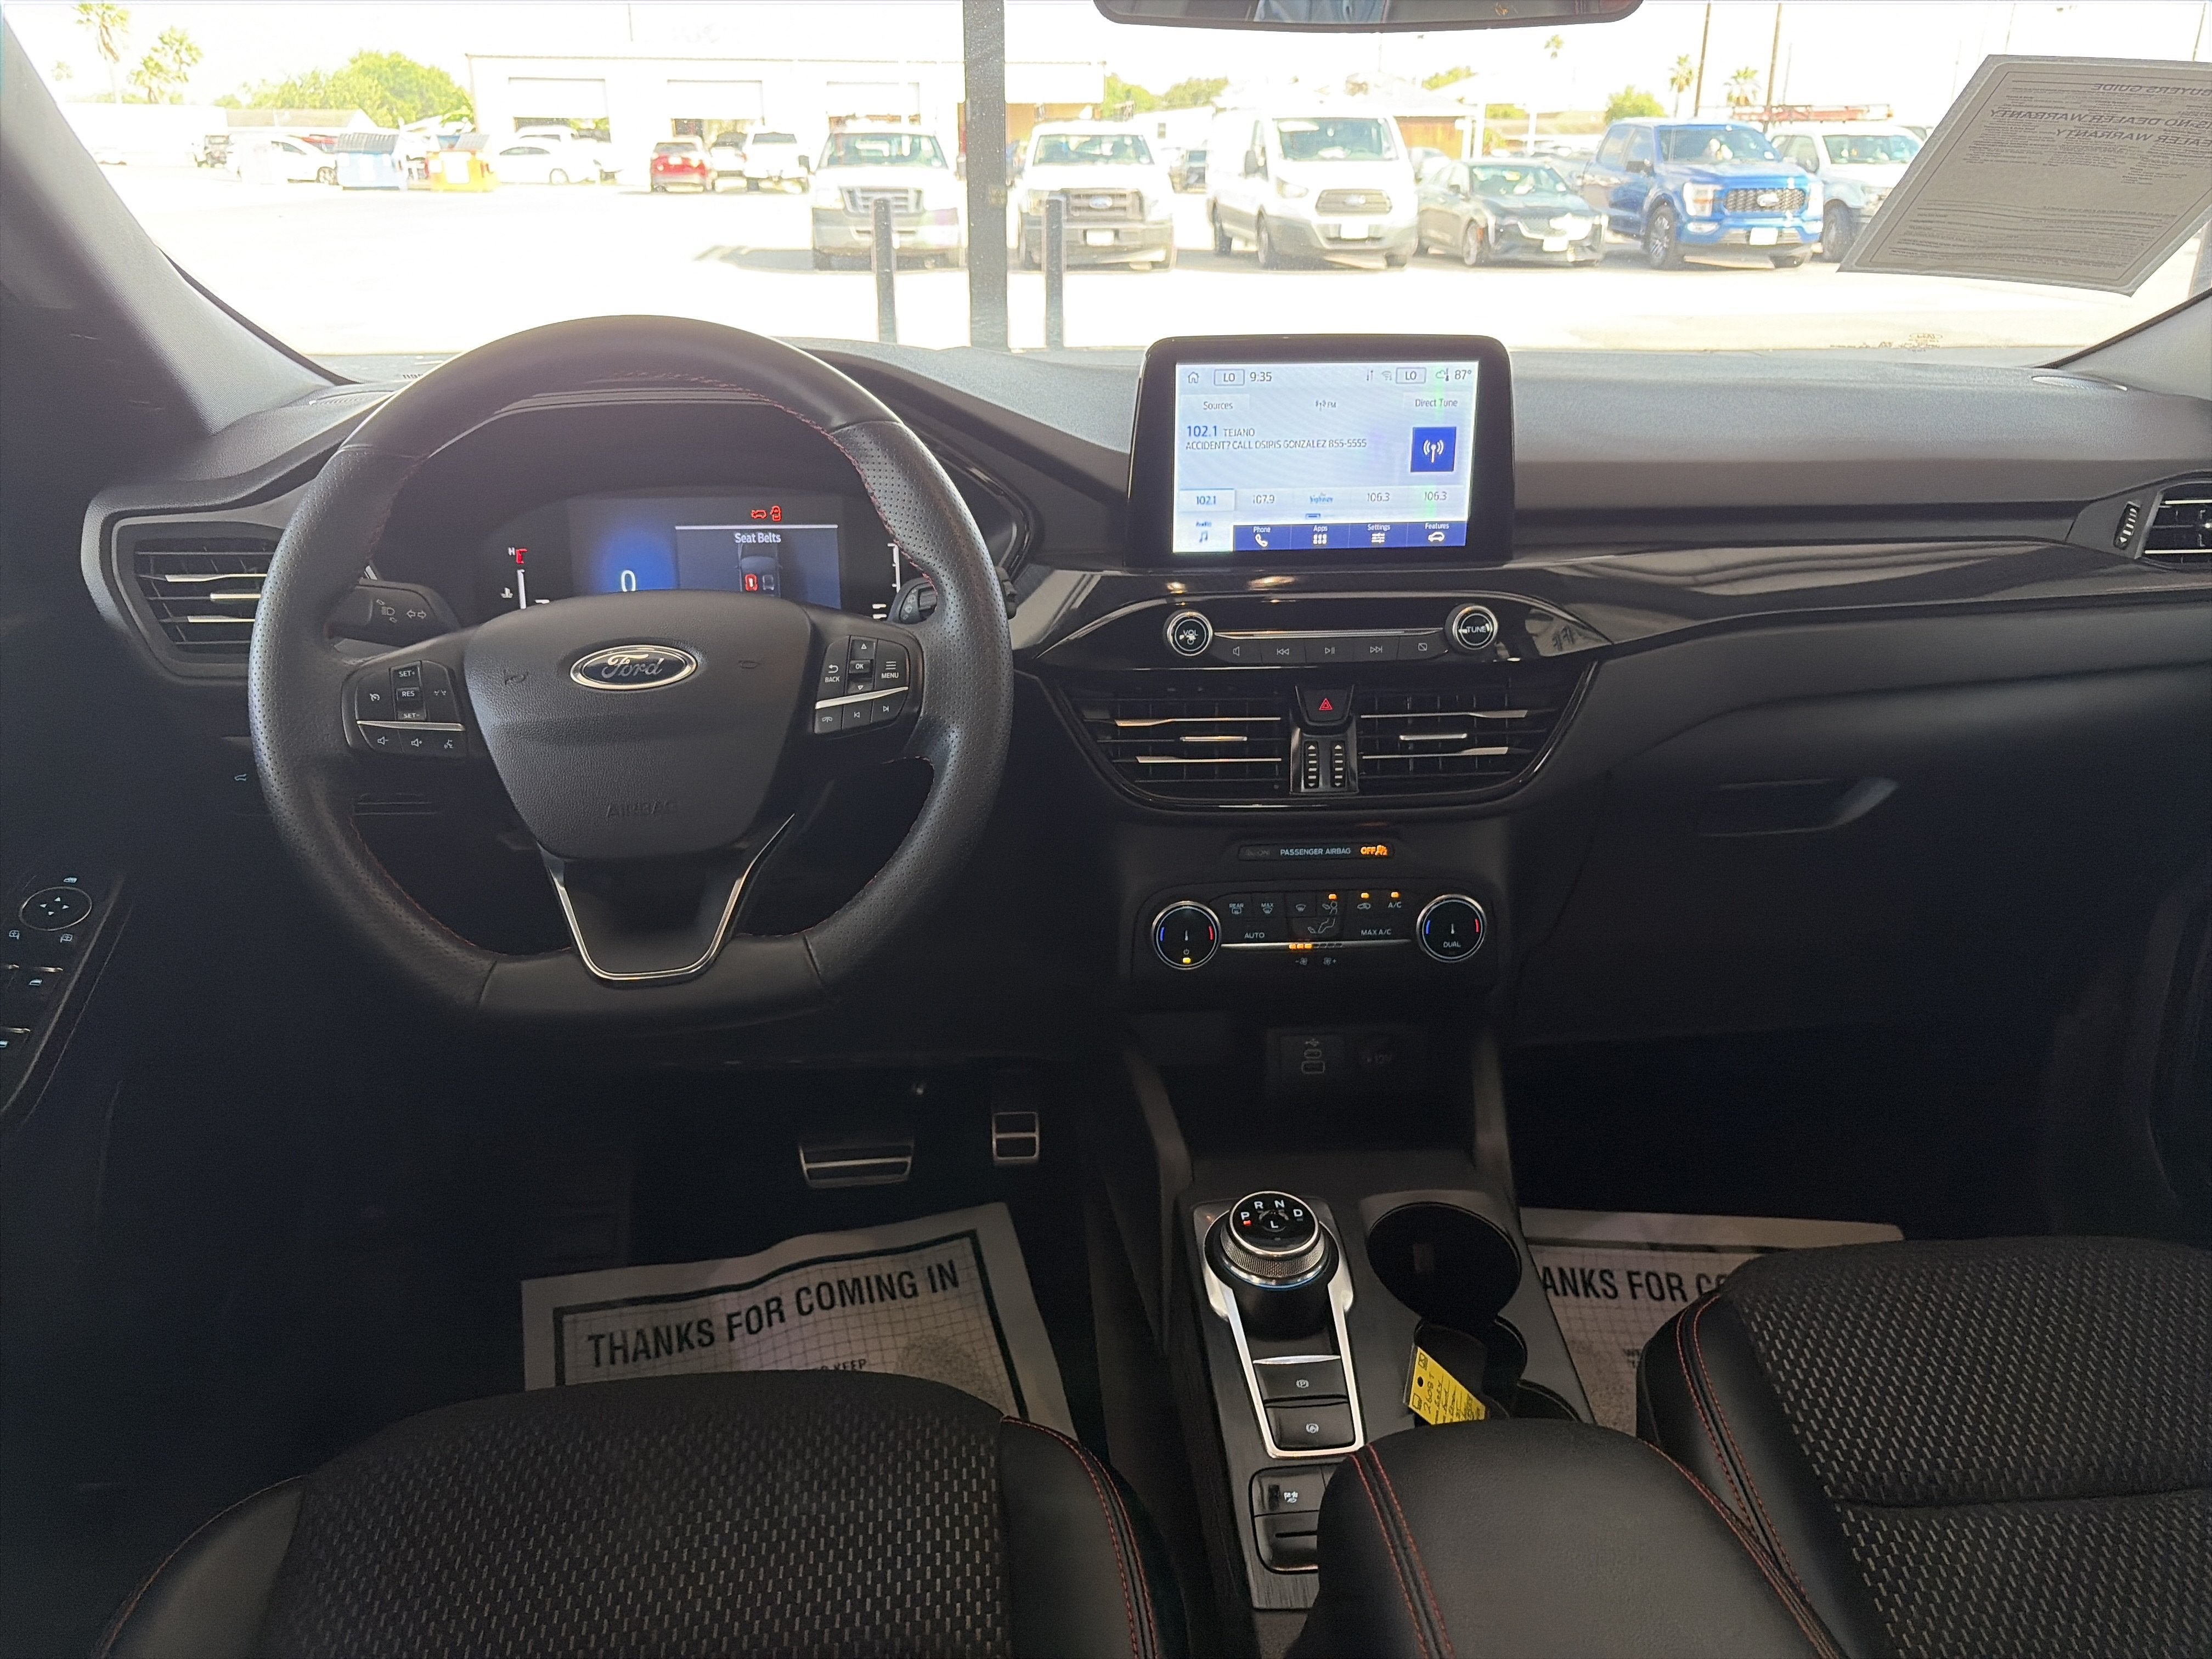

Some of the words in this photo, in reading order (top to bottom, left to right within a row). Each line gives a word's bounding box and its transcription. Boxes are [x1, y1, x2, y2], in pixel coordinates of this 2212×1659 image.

[1223, 373, 1235, 382] LO
[1249, 371, 1272, 382] 9:35
[1405, 371, 1417, 380] LO
[1454, 369, 1472, 380] 87°
[1203, 401, 1233, 410] Sources
[1415, 399, 1437, 407] Direct
[1439, 398, 1458, 407] Tune
[1187, 426, 1217, 437] 102.1
[1223, 428, 1255, 437] TEJANO
[1186, 441, 1231, 449] ACCIDENT?
[1232, 441, 1252, 449] CALL
[1252, 494, 1275, 504] 107.9
[1367, 492, 1390, 502] 106.3
[1424, 492, 1447, 501] 106.3
[735, 532, 756, 543] Seat
[758, 532, 781, 543] Belts
[508, 547, 515, 556] H
[601, 654, 665, 678] Ford
[1361, 847, 1376, 855] OFF
[1240, 1211, 1250, 1220] P
[1254, 1201, 1263, 1209] R
[1274, 1199, 1285, 1208] N
[1293, 1209, 1303, 1217] D
[1270, 1220, 1279, 1228] L
[1541, 1266, 1619, 1299] ANKS
[1627, 1269, 1688, 1302] FOR
[588, 1318, 715, 1368] THANKS
[726, 1296, 786, 1342] FOR
[795, 1271, 919, 1316] COMING
[927, 1259, 959, 1294] IN
